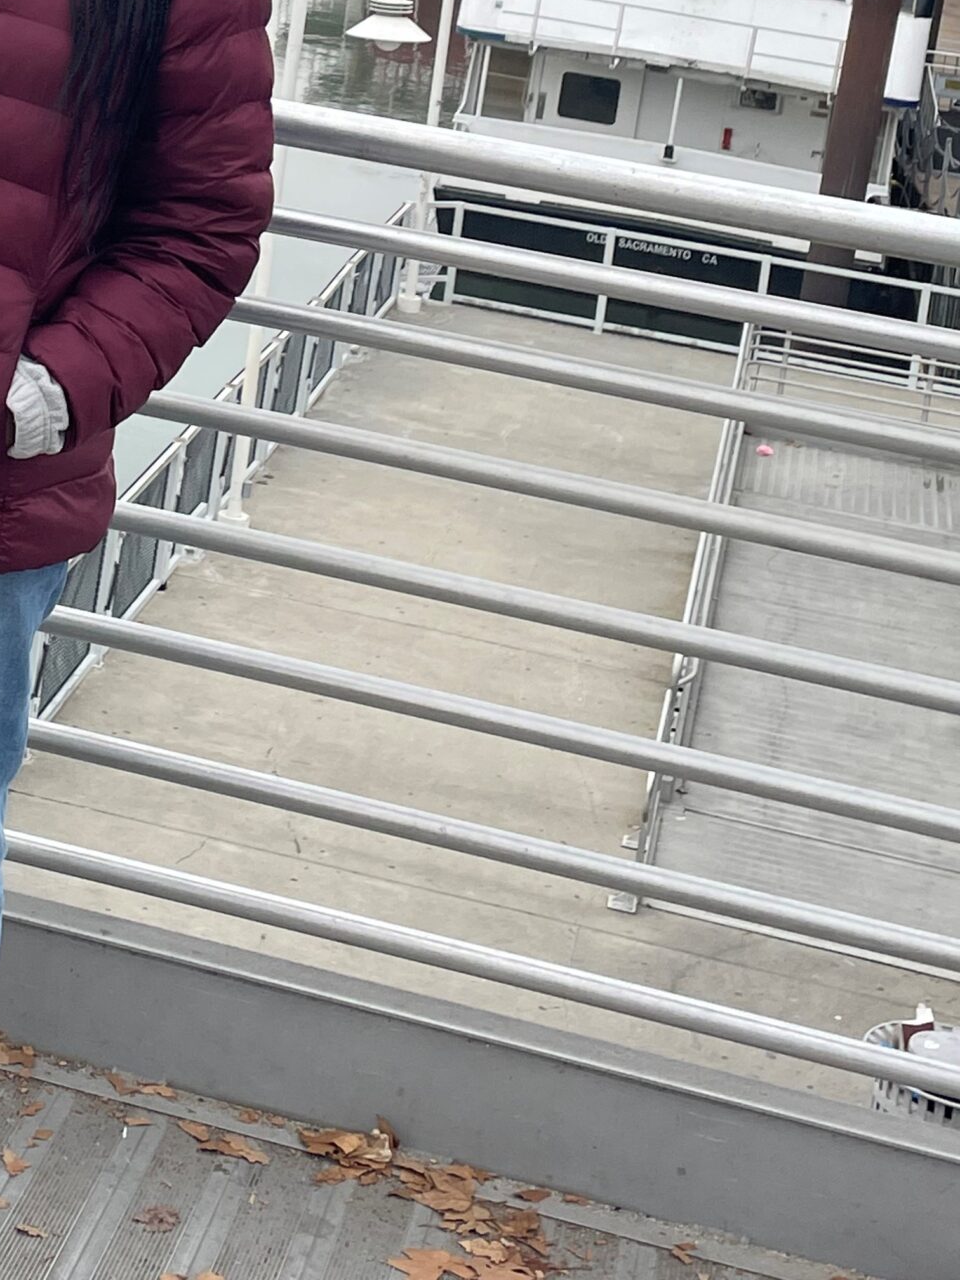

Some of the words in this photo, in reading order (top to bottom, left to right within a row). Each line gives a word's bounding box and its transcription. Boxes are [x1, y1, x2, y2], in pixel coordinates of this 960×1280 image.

[586, 232, 607, 245] OLD
[618, 237, 692, 260] SACRAMENTO
[701, 253, 718, 265] CA
